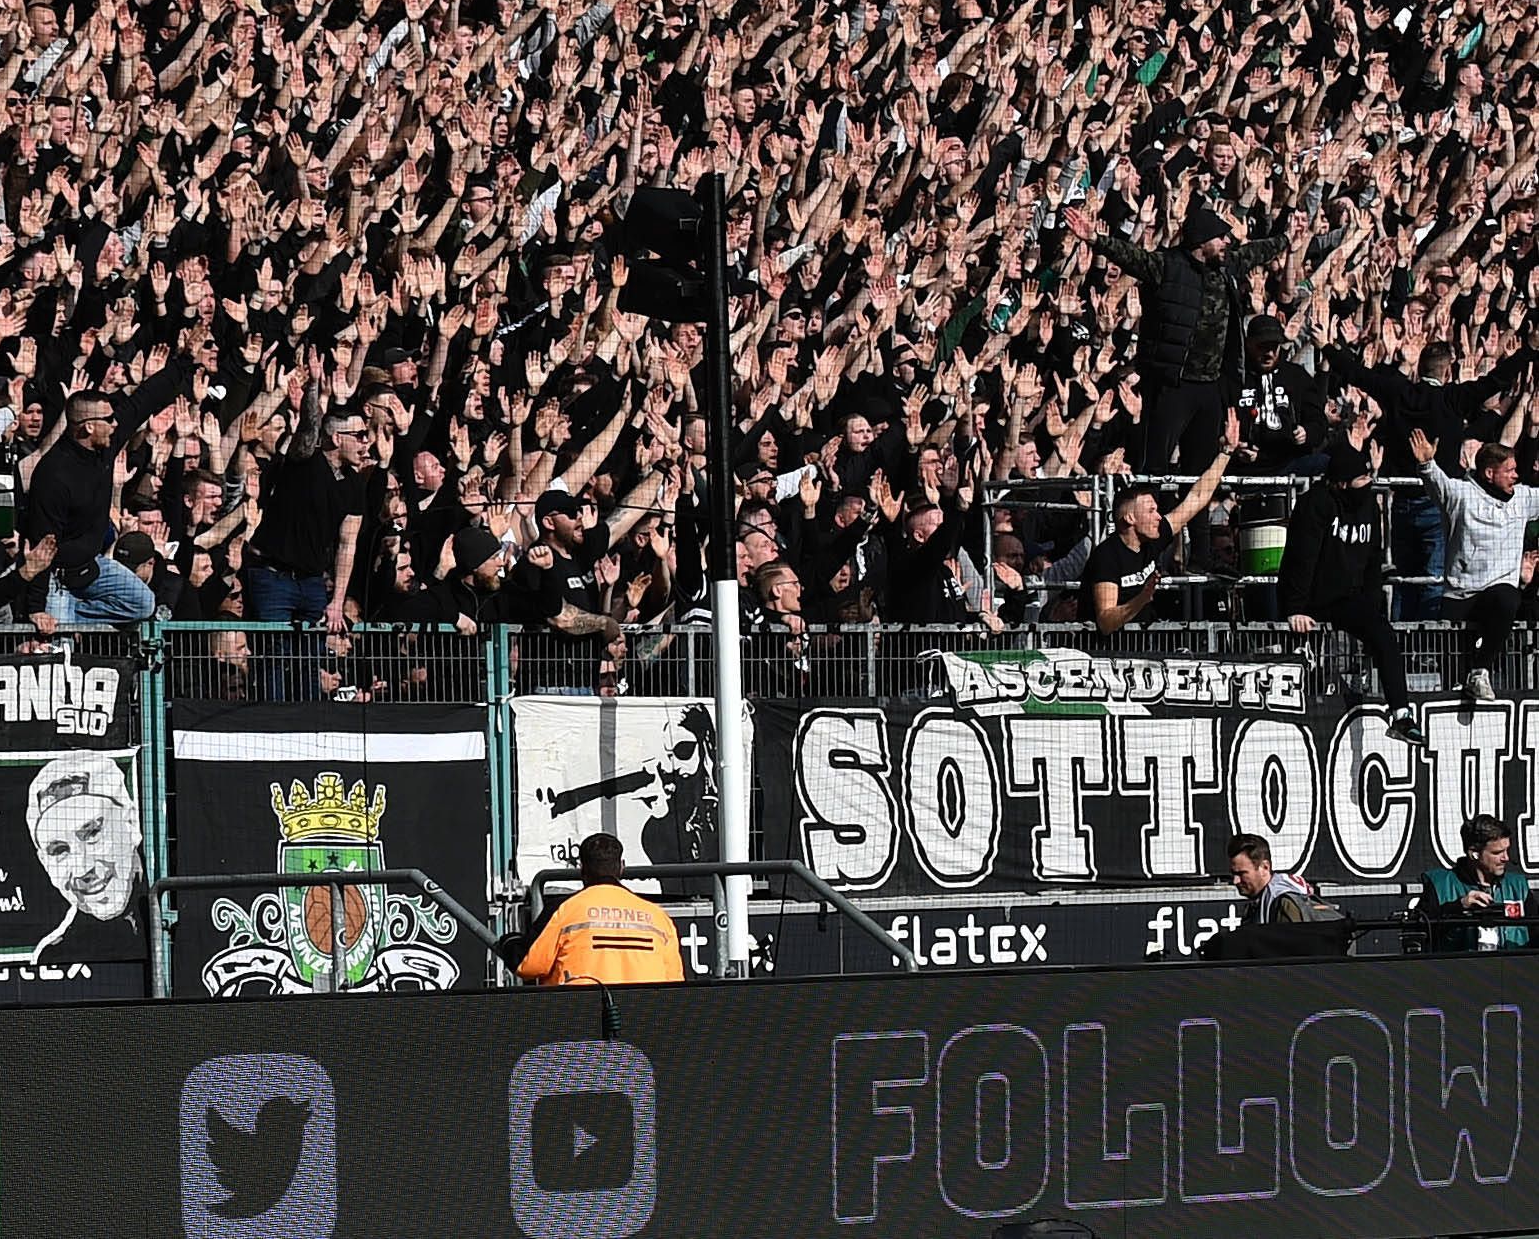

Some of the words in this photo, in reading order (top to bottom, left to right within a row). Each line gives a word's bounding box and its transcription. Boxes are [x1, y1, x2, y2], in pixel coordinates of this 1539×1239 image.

[956, 659, 1306, 713] ASCENDENTE
[795, 700, 1539, 890] SOTTOCU
[888, 914, 1049, 966] flatex
[832, 1004, 1523, 1225] FOLLOW
